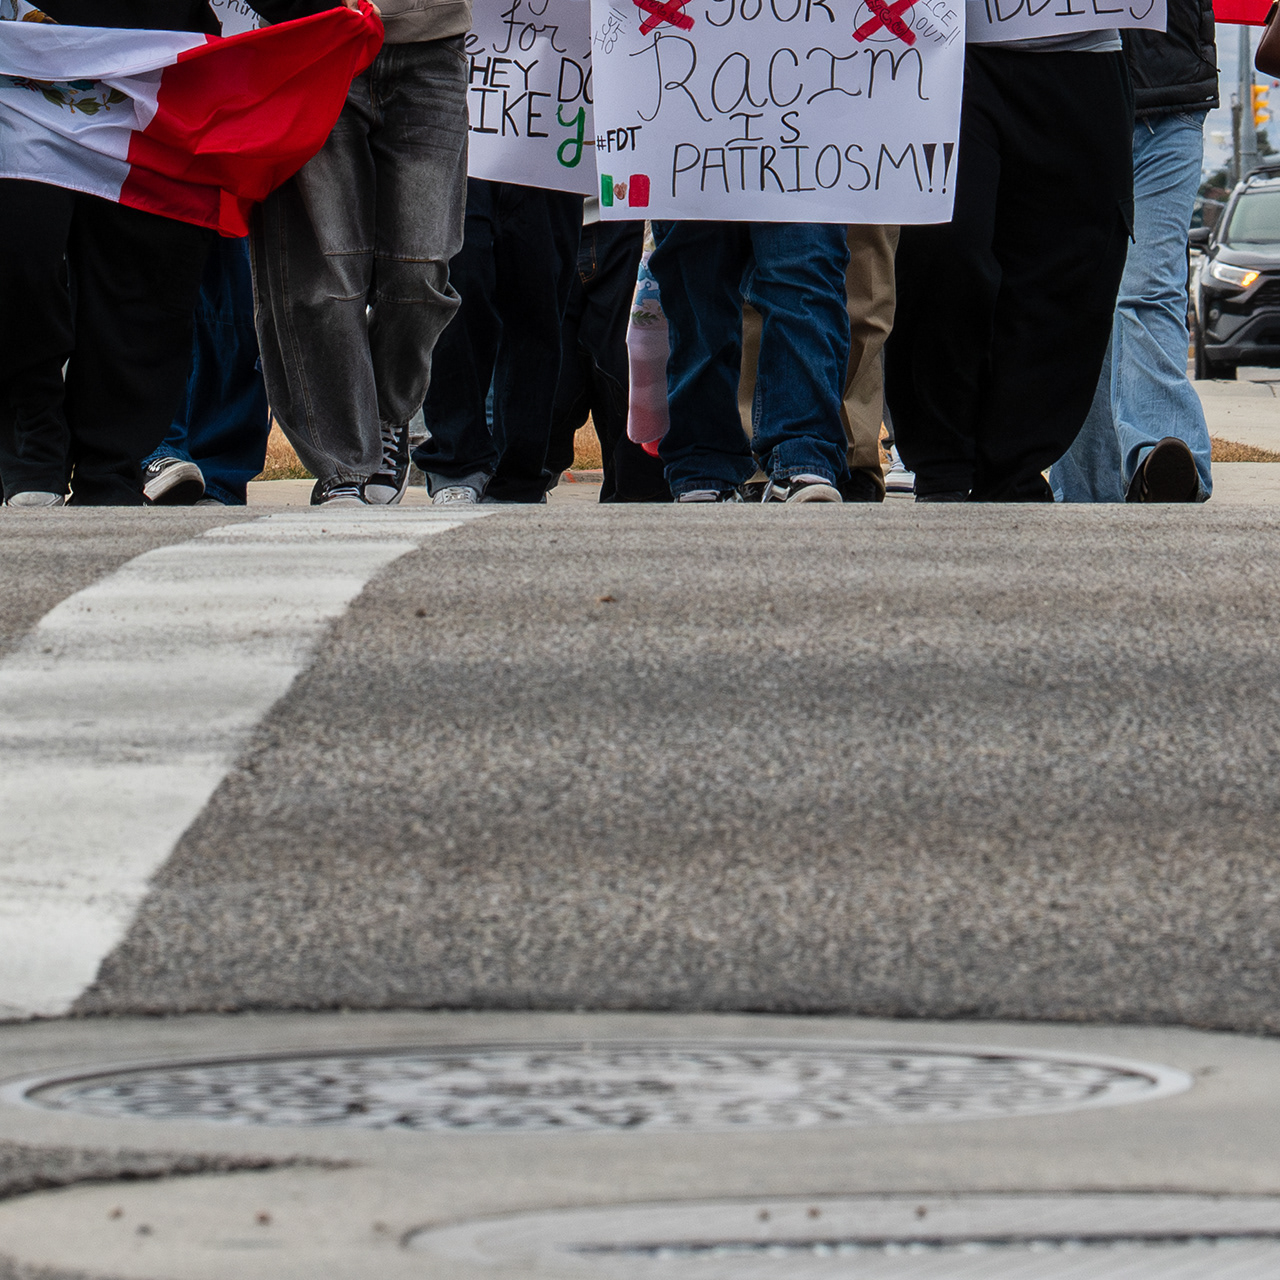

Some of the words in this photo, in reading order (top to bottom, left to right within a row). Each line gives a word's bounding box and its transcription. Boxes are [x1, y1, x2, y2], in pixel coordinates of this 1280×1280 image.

[470, 56, 539, 90] HEY
[469, 87, 551, 138] IKE
[726, 110, 801, 146] IS
[596, 125, 642, 152] #FDT
[672, 142, 954, 197] PATRIOSM!!
